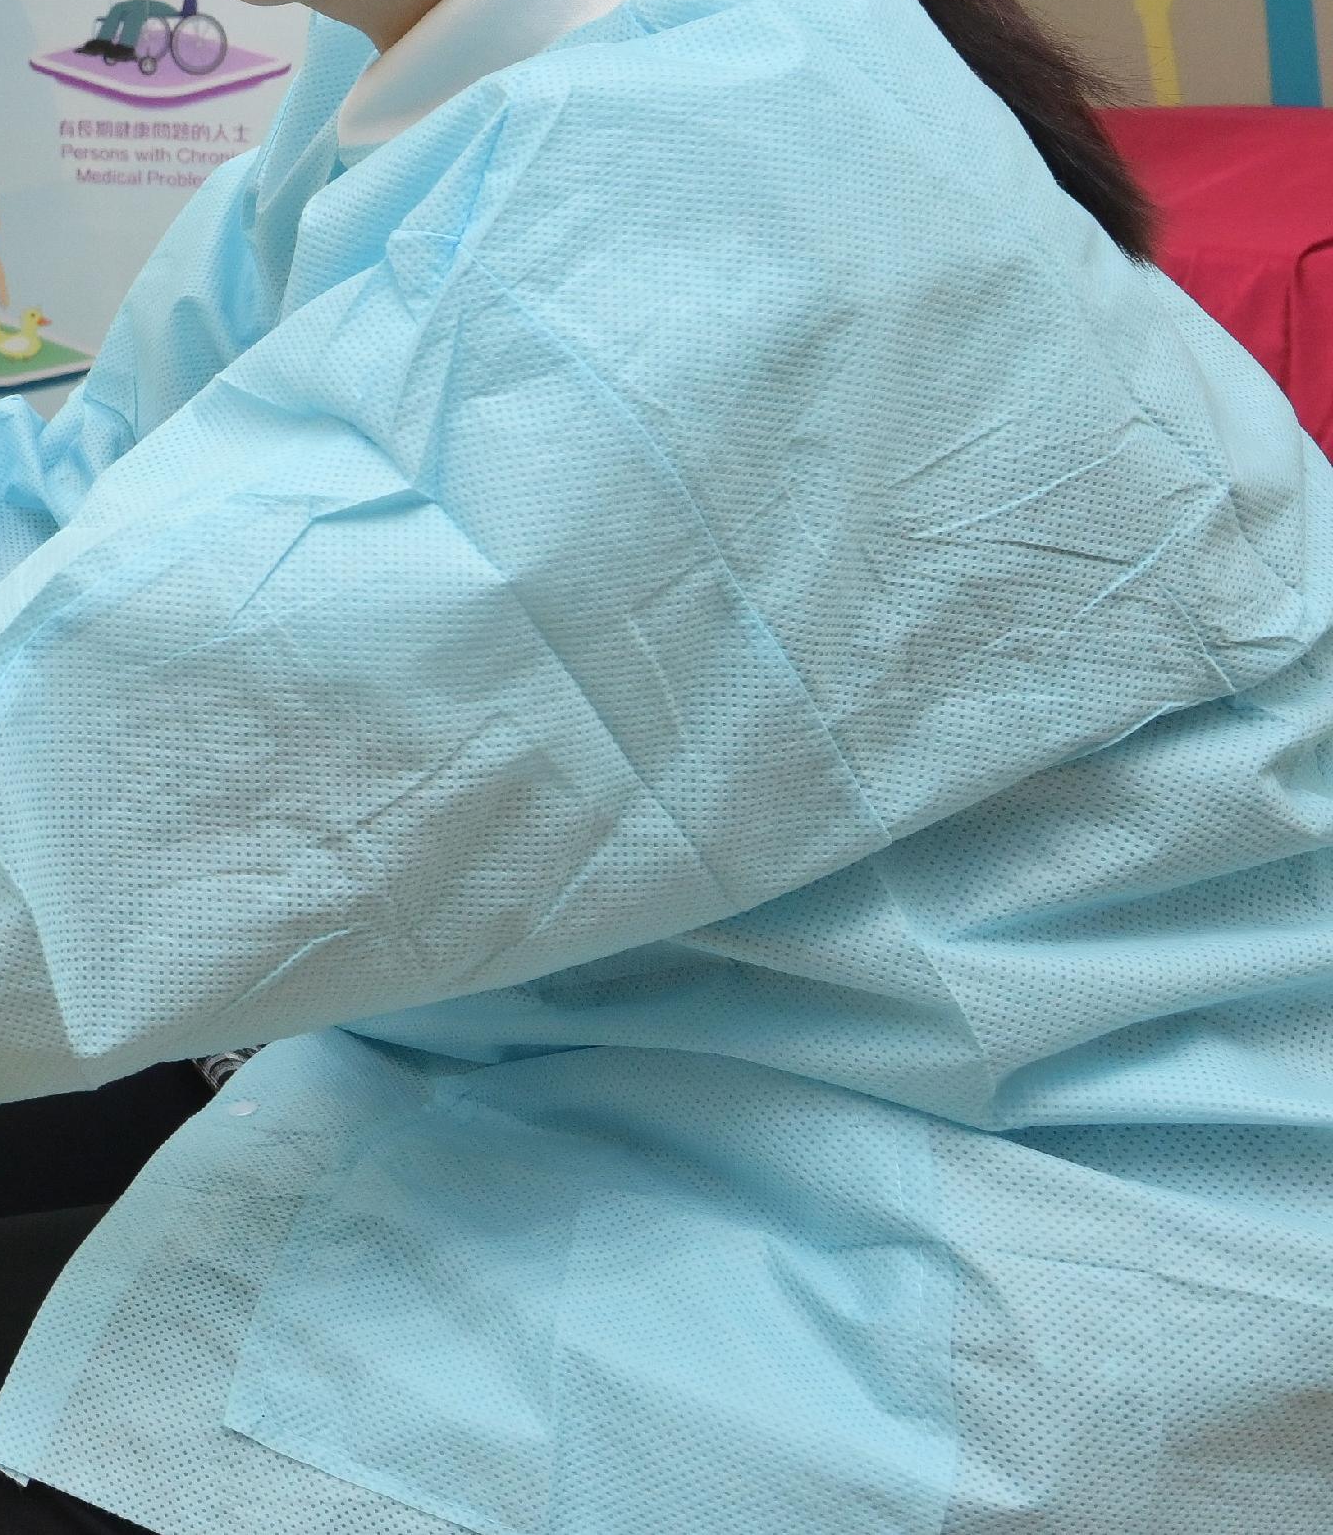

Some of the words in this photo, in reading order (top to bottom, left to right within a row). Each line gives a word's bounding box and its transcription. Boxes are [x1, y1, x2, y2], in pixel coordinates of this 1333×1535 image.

[60, 143, 130, 163] Persons
[135, 145, 172, 164] with
[76, 168, 143, 186] Medical
[147, 169, 205, 187] Proble
